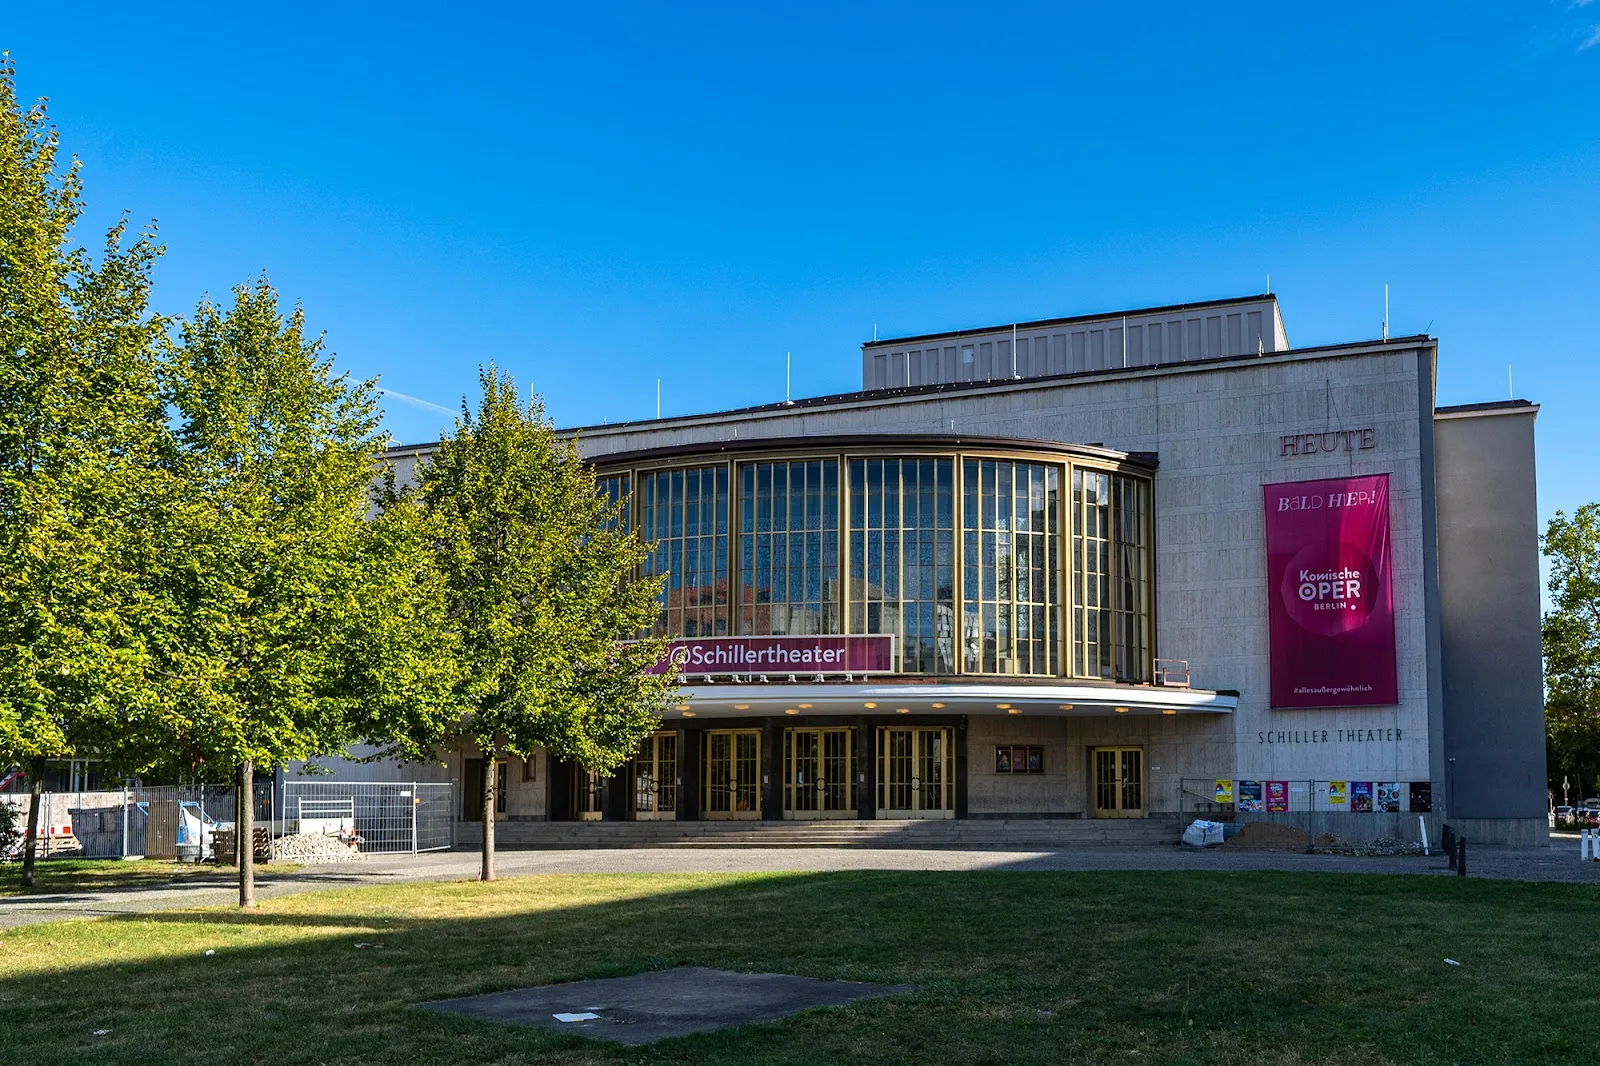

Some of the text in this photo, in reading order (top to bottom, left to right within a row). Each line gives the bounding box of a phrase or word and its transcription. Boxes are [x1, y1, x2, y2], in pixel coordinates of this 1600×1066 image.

[1280, 428, 1375, 456] HEUTE
[1328, 490, 1376, 508] HIER!
[1300, 567, 1360, 582] Komische
[1299, 580, 1361, 601] OPER
[670, 643, 845, 666] @Schillertheater
[1258, 728, 1402, 744] SCHILLER THEATER
